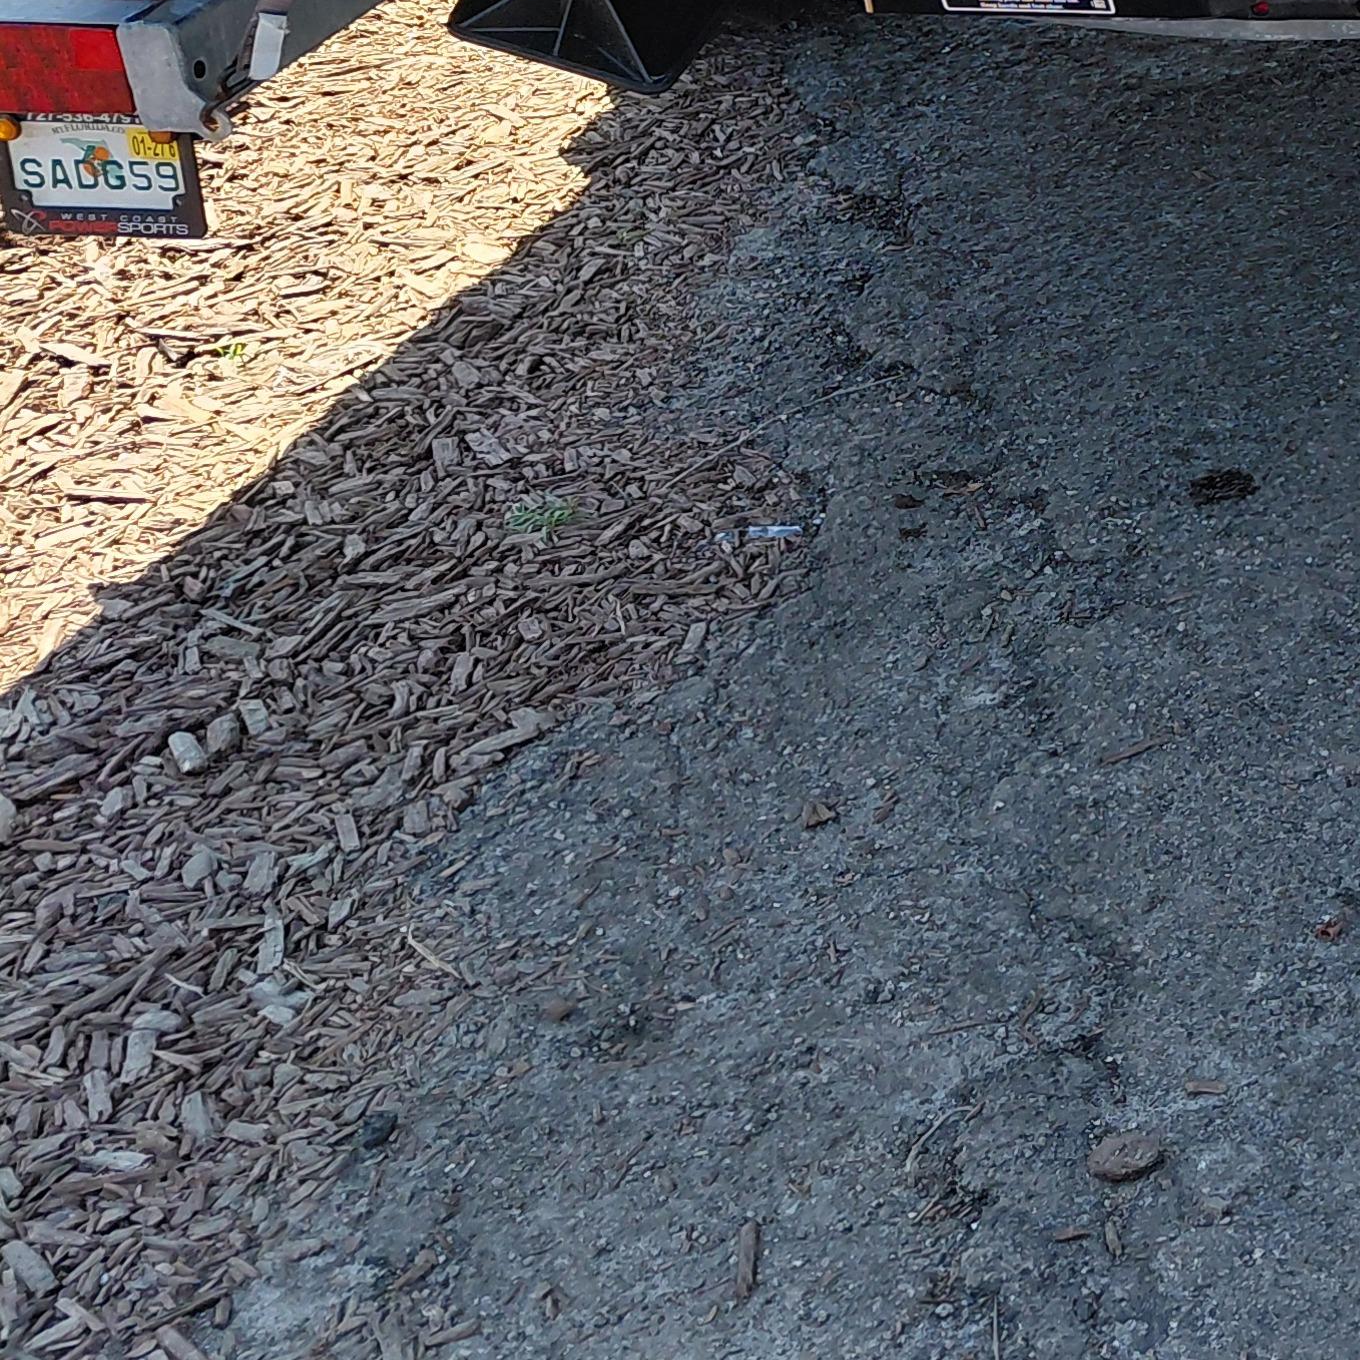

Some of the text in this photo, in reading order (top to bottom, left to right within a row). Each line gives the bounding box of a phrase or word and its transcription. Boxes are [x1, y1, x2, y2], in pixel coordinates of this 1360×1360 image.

[19, 157, 181, 192] SADG59
[60, 213, 179, 223] WEST COAST
